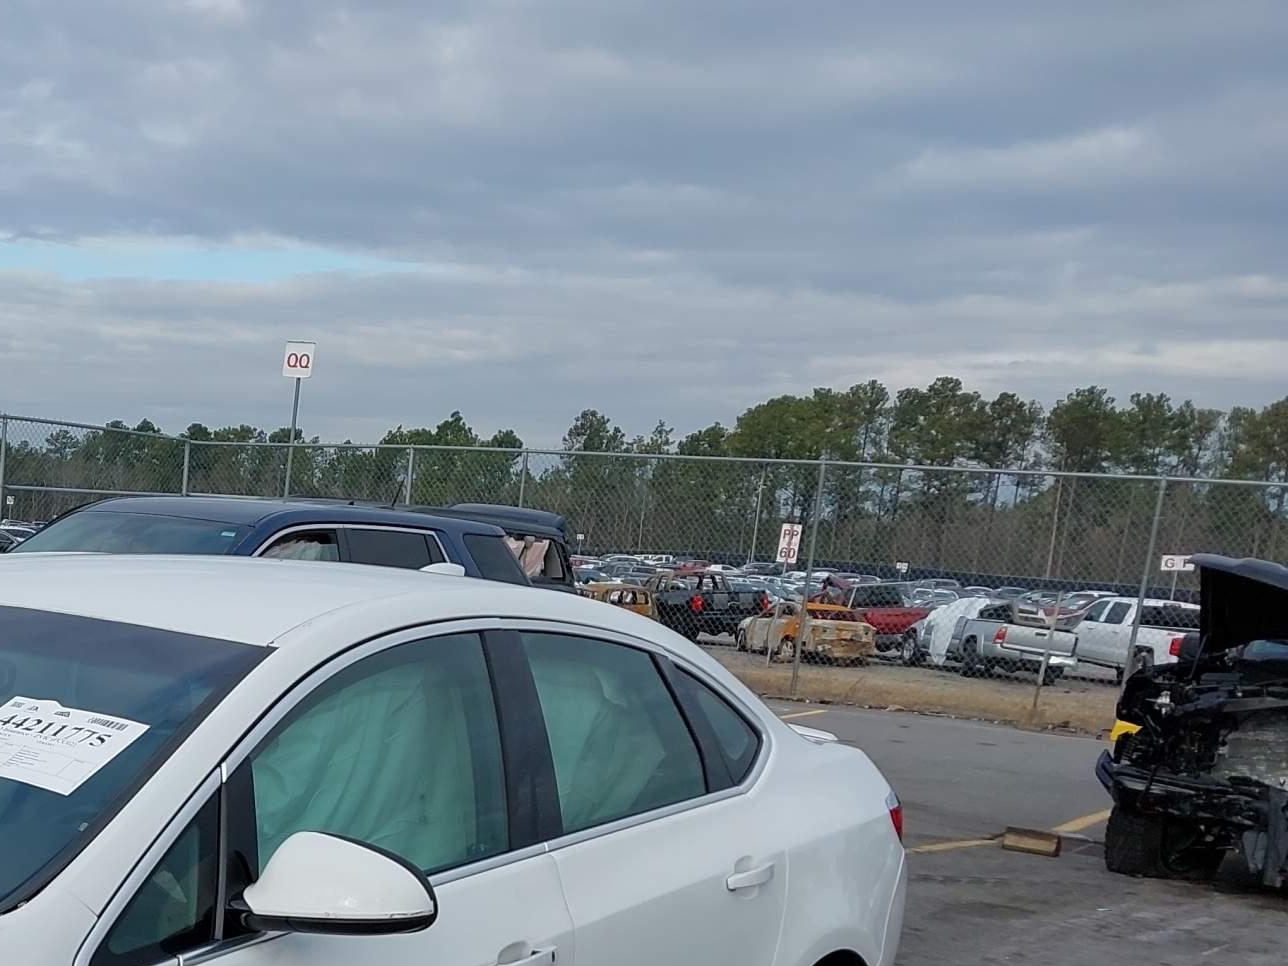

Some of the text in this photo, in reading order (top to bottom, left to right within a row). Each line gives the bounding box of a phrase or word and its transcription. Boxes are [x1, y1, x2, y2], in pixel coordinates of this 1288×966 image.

[287, 352, 310, 369] QQ
[782, 529, 799, 540] PP
[779, 546, 796, 559] 60
[1165, 557, 1176, 569] G
[0, 714, 112, 747] 44211775
